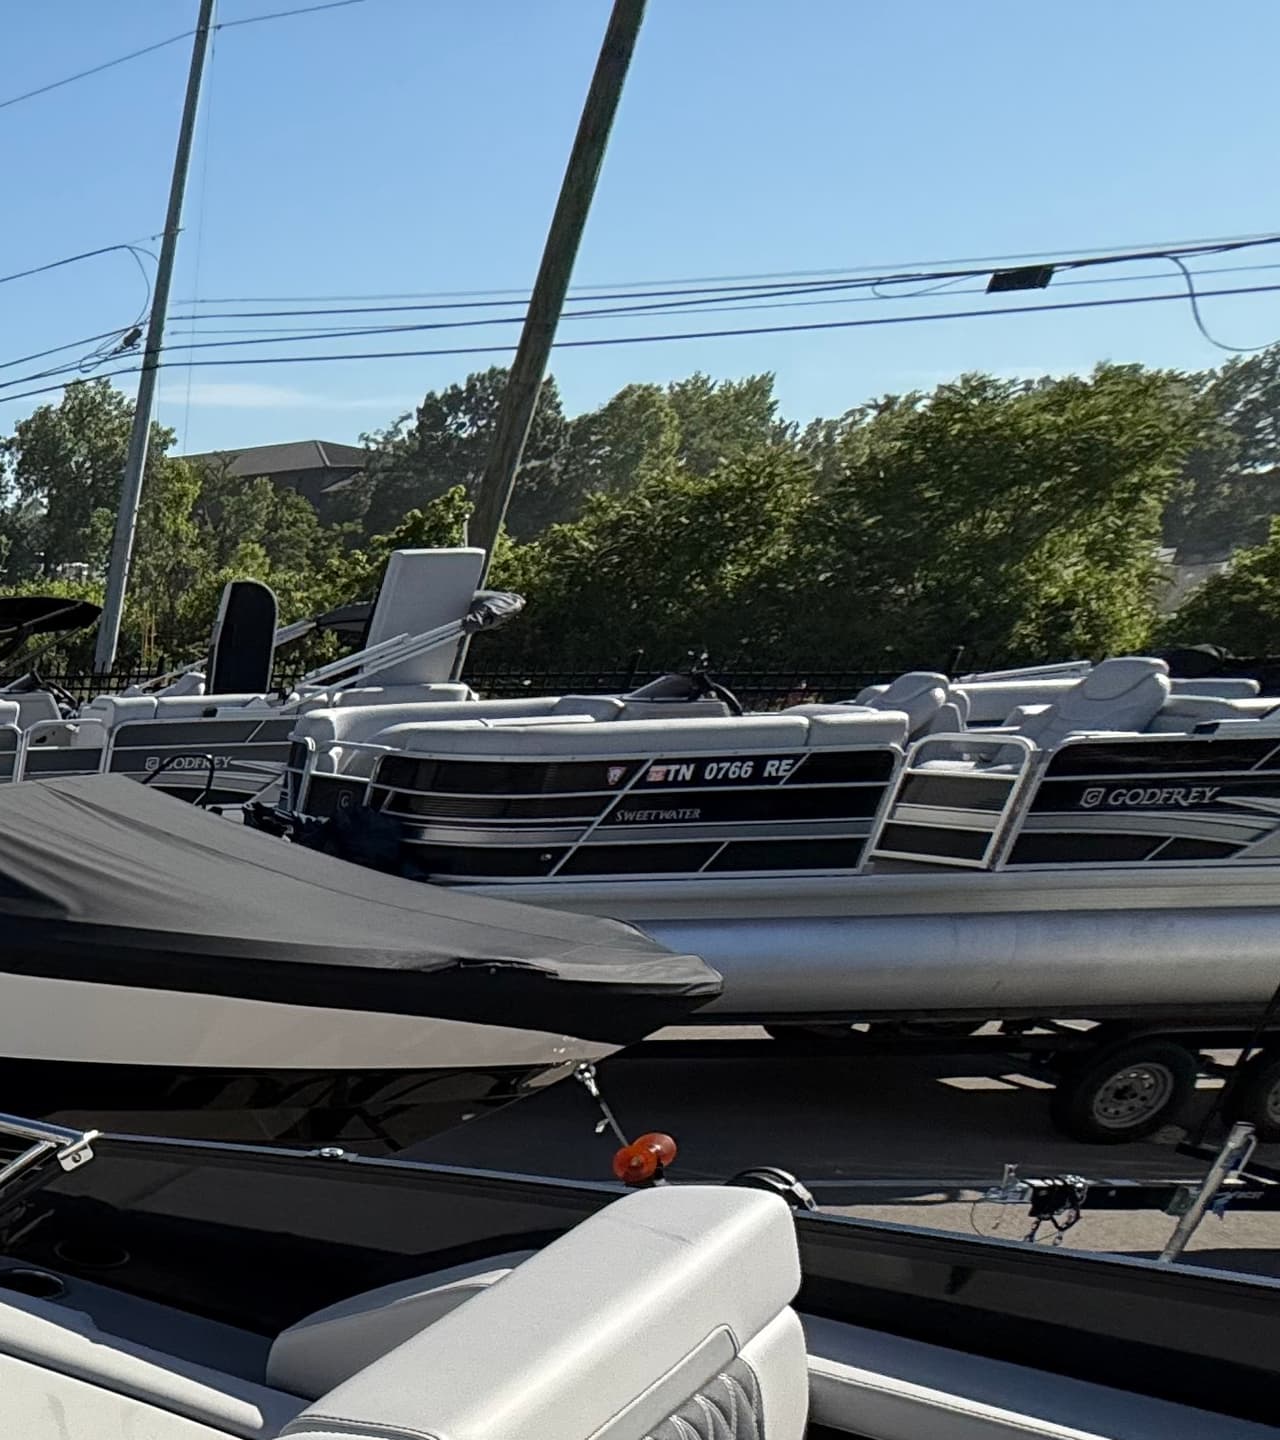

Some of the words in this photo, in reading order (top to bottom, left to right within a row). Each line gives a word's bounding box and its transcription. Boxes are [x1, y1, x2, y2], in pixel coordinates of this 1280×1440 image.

[667, 764, 696, 782] TN
[704, 761, 754, 780] 0766
[763, 759, 794, 778] RE
[1108, 786, 1221, 807] GODFREY
[616, 808, 701, 823] SWEETWATER
